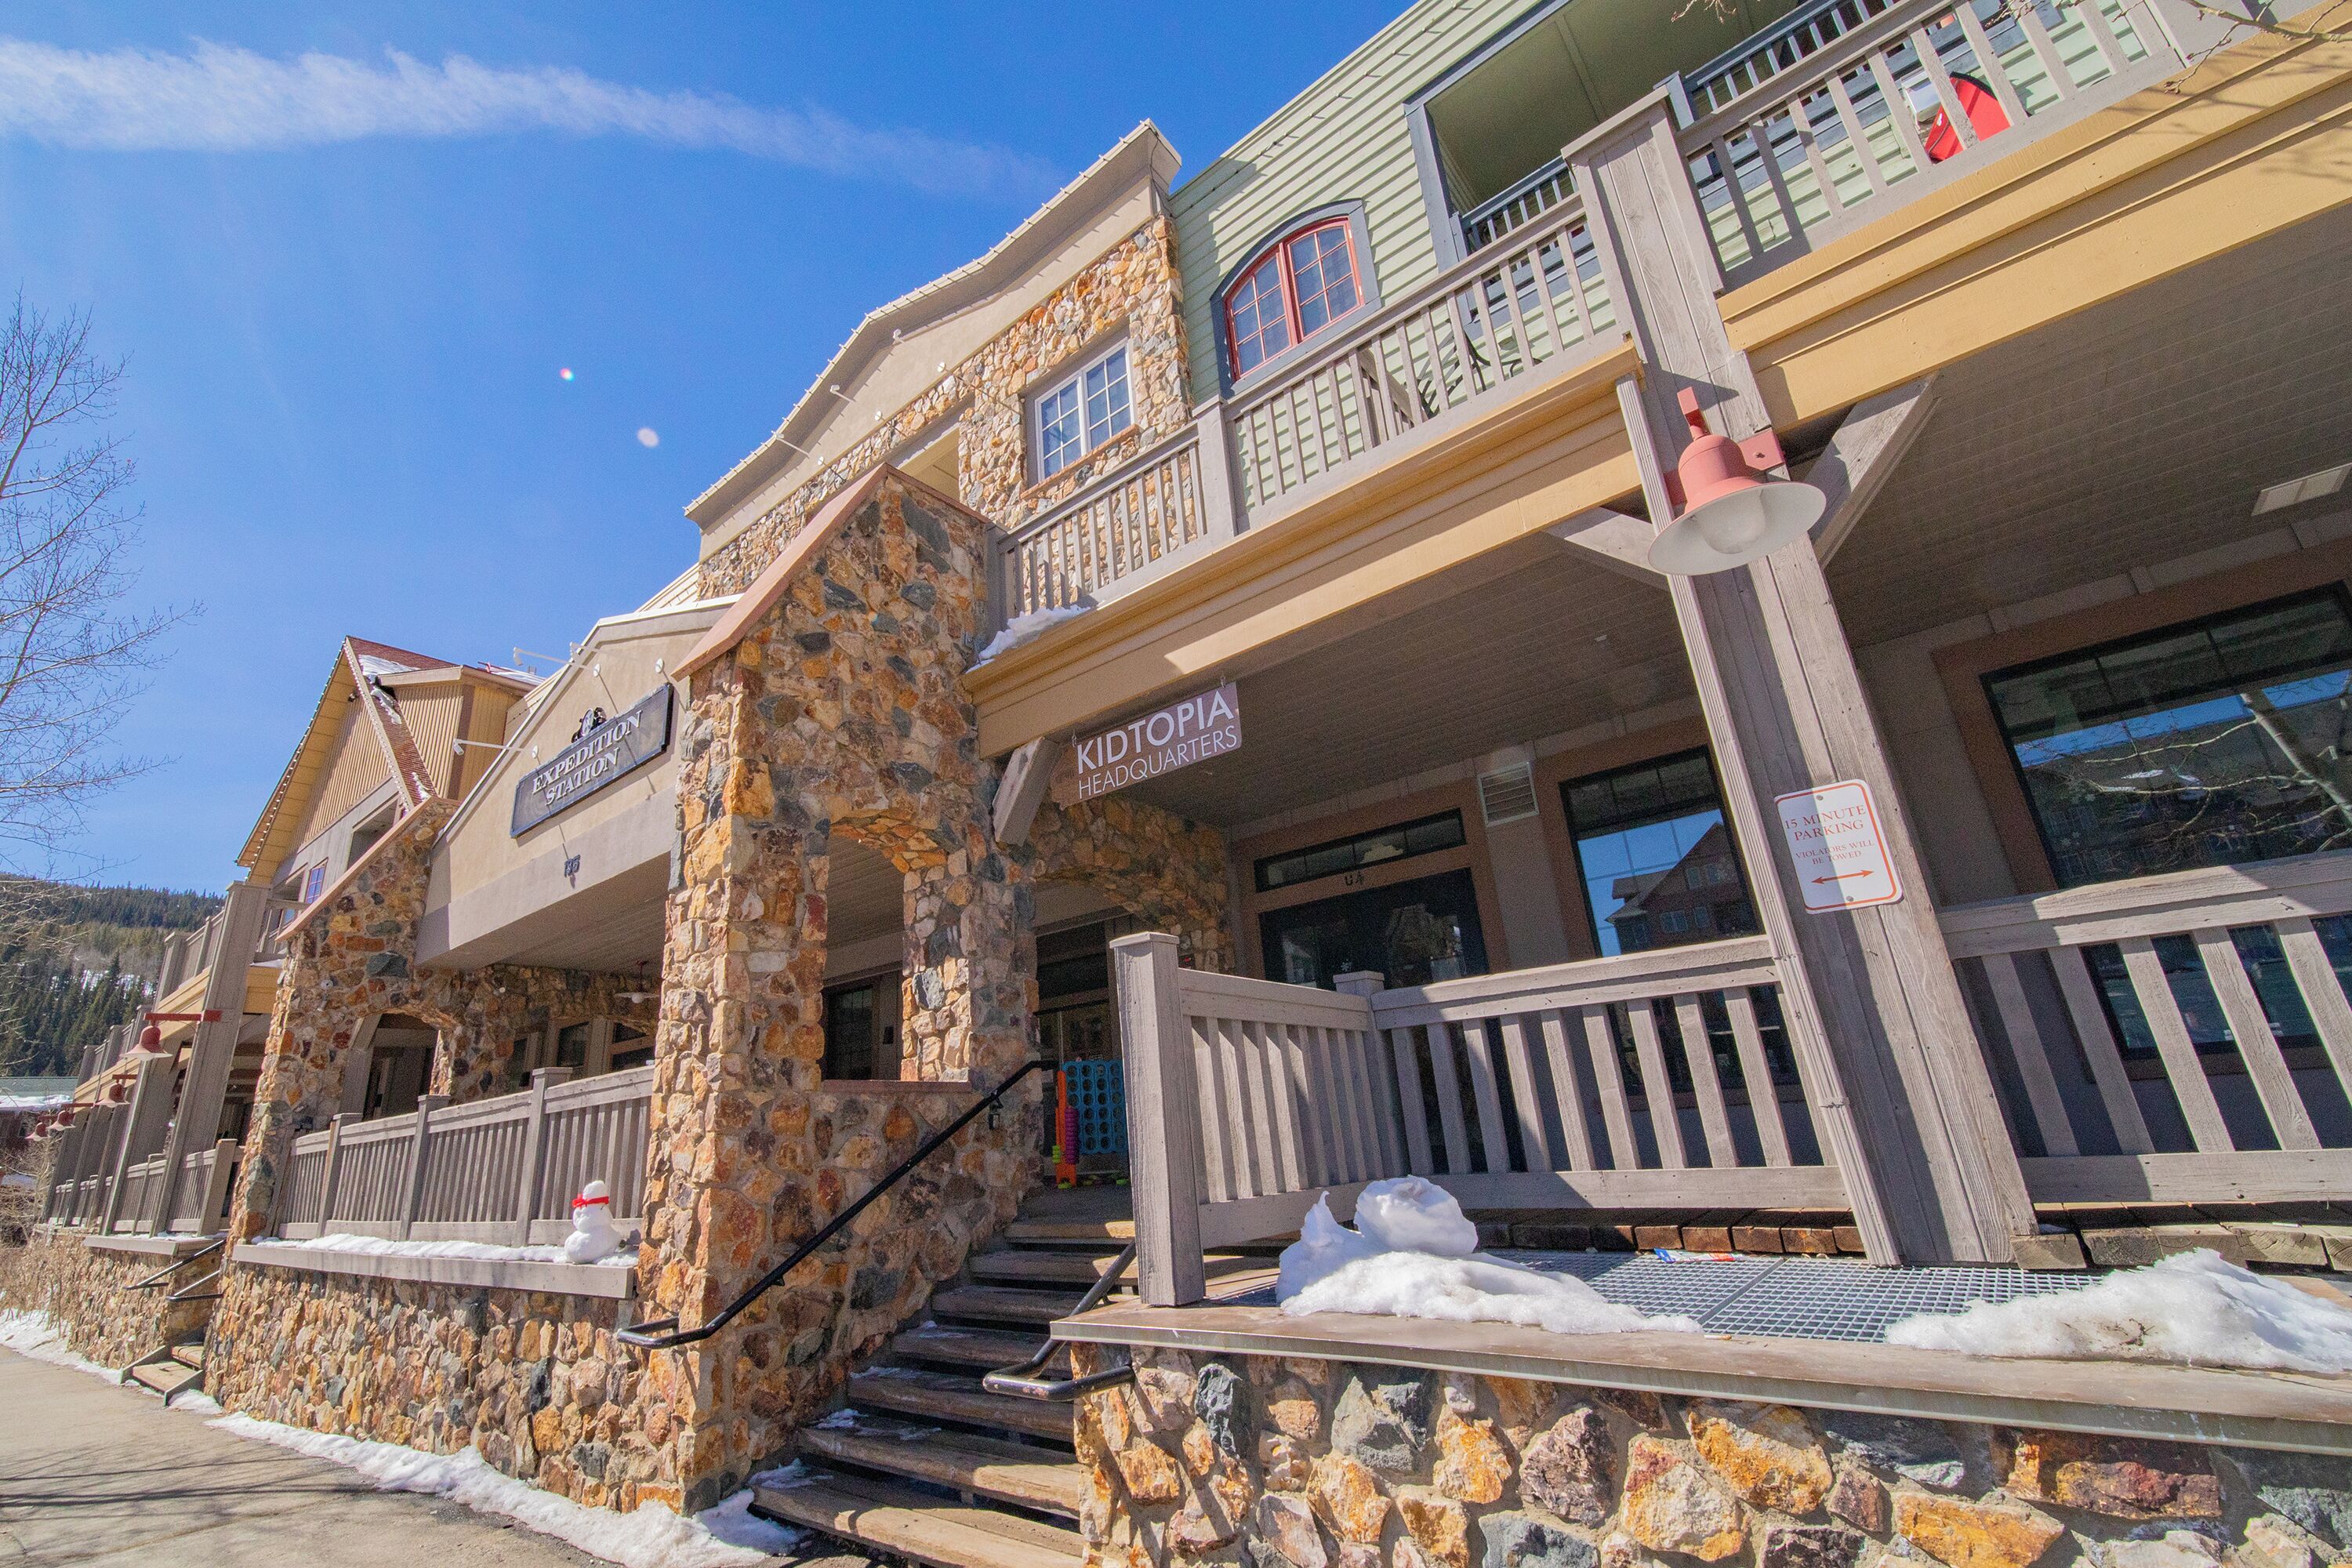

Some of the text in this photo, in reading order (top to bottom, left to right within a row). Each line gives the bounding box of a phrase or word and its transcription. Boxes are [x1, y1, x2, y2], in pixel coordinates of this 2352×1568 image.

[532, 710, 642, 795] EXPEDITION
[1078, 690, 1234, 774] KIDTOPIA
[545, 746, 620, 806] STATION
[1079, 725, 1236, 799] HEADQUARTERS
[1784, 804, 1866, 829] 15 MINUTE
[1794, 819, 1864, 841] PARKING
[1795, 840, 1875, 859] VIOLATORS WILL
[1828, 850, 1862, 862] TOWED
